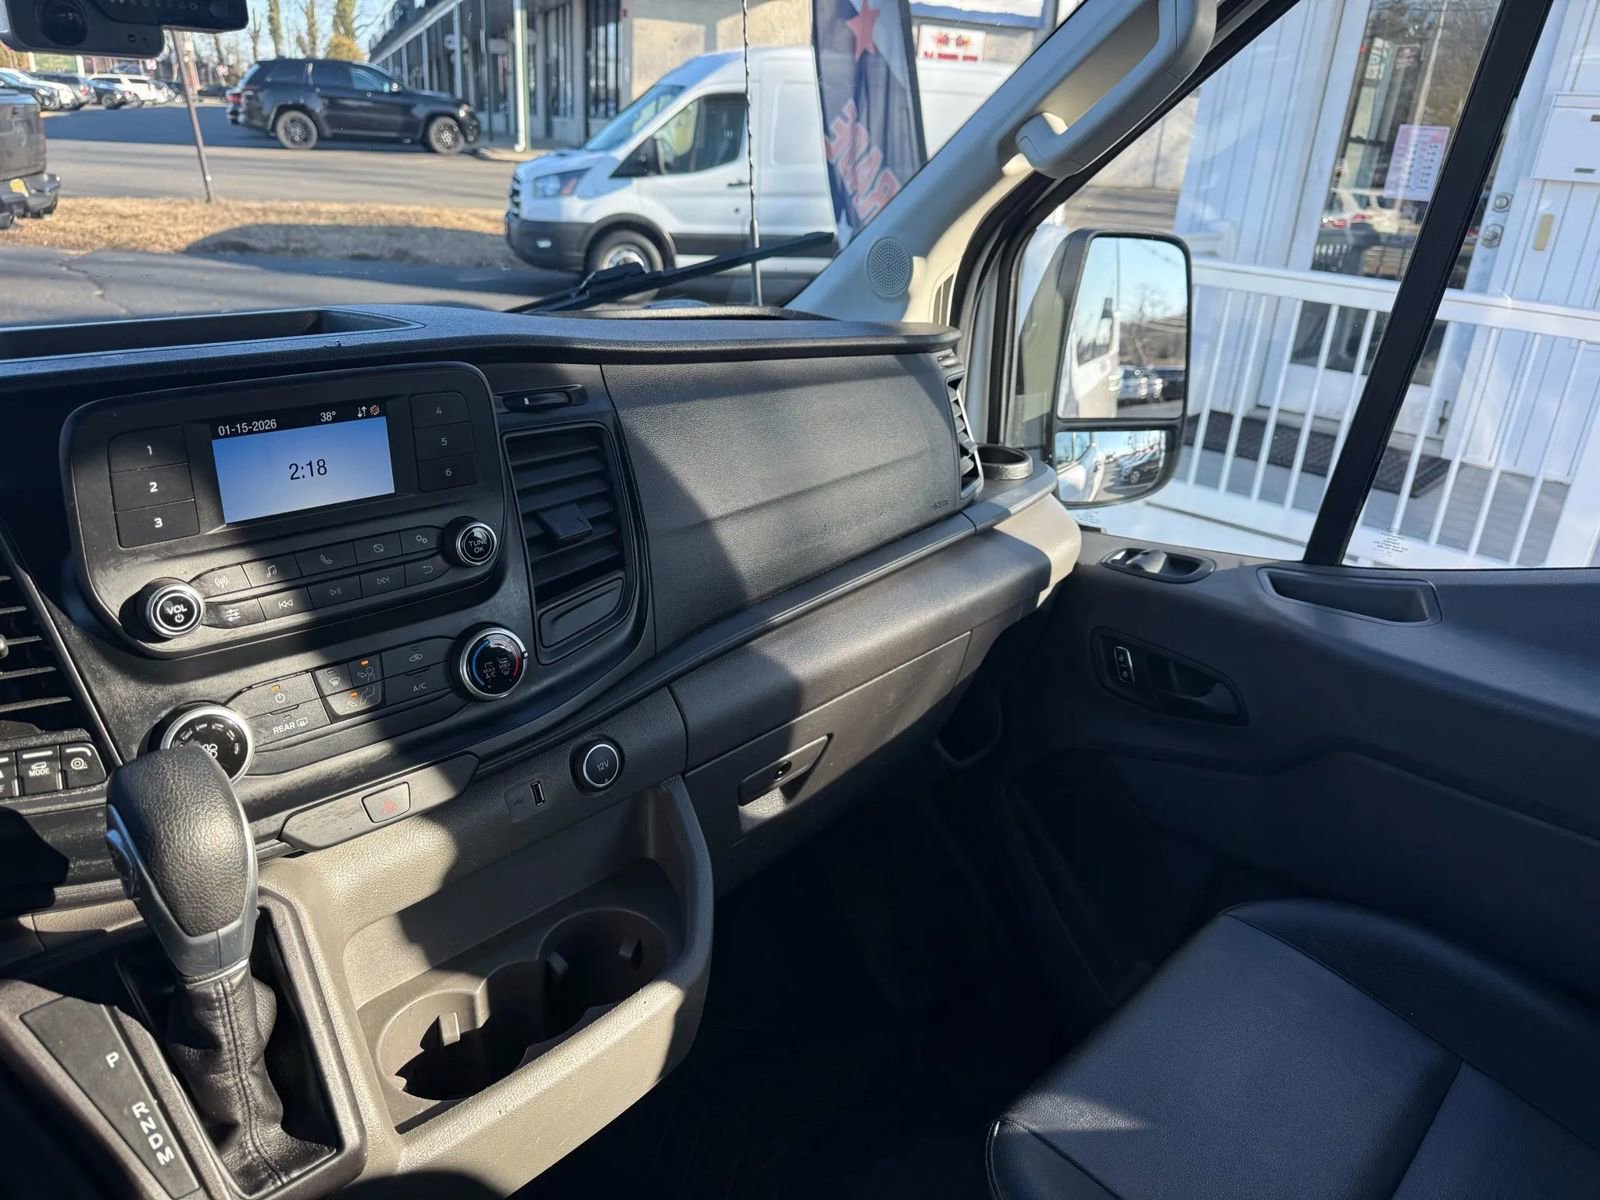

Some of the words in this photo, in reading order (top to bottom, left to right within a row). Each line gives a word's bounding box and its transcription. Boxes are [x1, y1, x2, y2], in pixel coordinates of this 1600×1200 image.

[435, 406, 442, 415] 4
[217, 418, 278, 437] 01-15-2026
[320, 410, 337, 423] 38°
[440, 437, 448, 447] 5
[146, 444, 153, 456] 1
[288, 458, 328, 481] 2:18
[445, 467, 453, 477] 6
[149, 481, 159, 493] 2
[153, 517, 164, 529] 3
[468, 539, 488, 548] TUNE
[473, 546, 485, 554] OK
[166, 603, 188, 616] VOL
[413, 682, 427, 693] A/C
[272, 721, 296, 735] REAR
[596, 760, 610, 772] 12V
[28, 767, 51, 778] MODE
[105, 1051, 119, 1069] P
[131, 1101, 150, 1119] R
[140, 1116, 157, 1134] N
[148, 1133, 164, 1150] D
[156, 1146, 175, 1166] M
